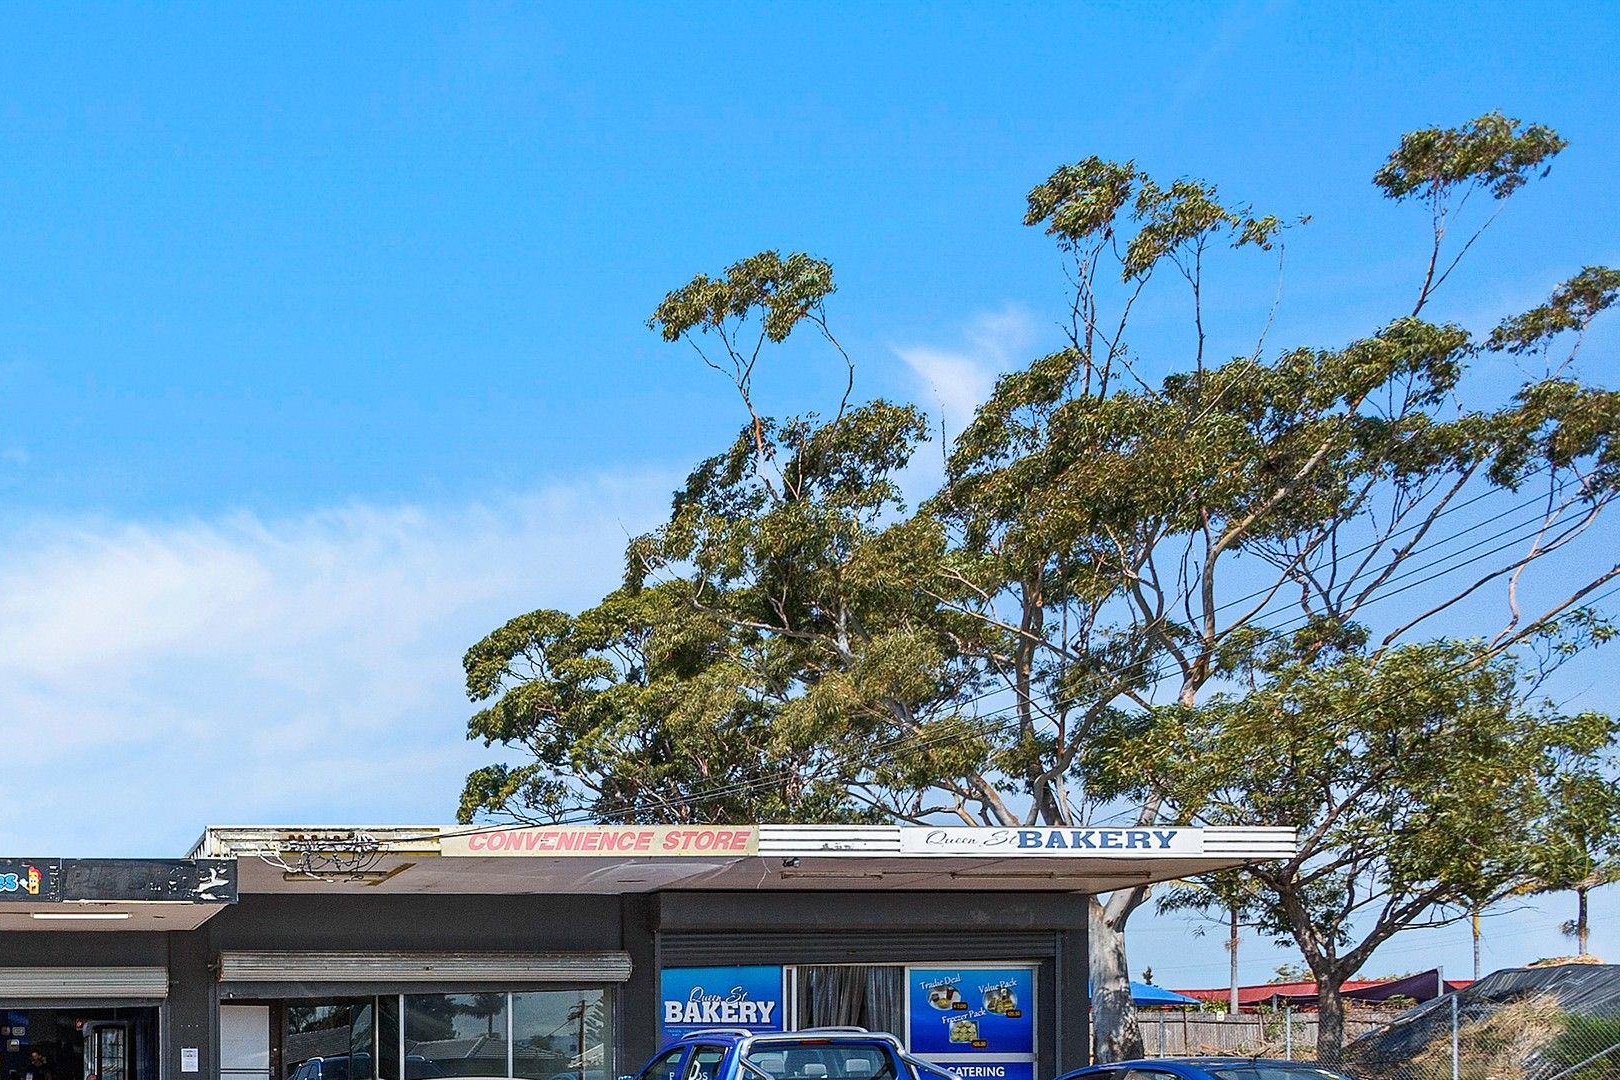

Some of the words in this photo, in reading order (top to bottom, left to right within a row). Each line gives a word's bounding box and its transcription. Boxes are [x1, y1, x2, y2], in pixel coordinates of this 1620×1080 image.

[468, 831, 653, 850] CONVENIENCE
[662, 831, 750, 850] STORE
[925, 830, 976, 847] Queen
[1017, 831, 1177, 848] BAKERY
[999, 977, 1018, 989] Pack
[689, 986, 721, 1003] Queen
[725, 985, 748, 1004] St
[664, 1000, 776, 1023] BAKERY
[941, 1013, 968, 1025] Freezer
[968, 1007, 987, 1019] Pack
